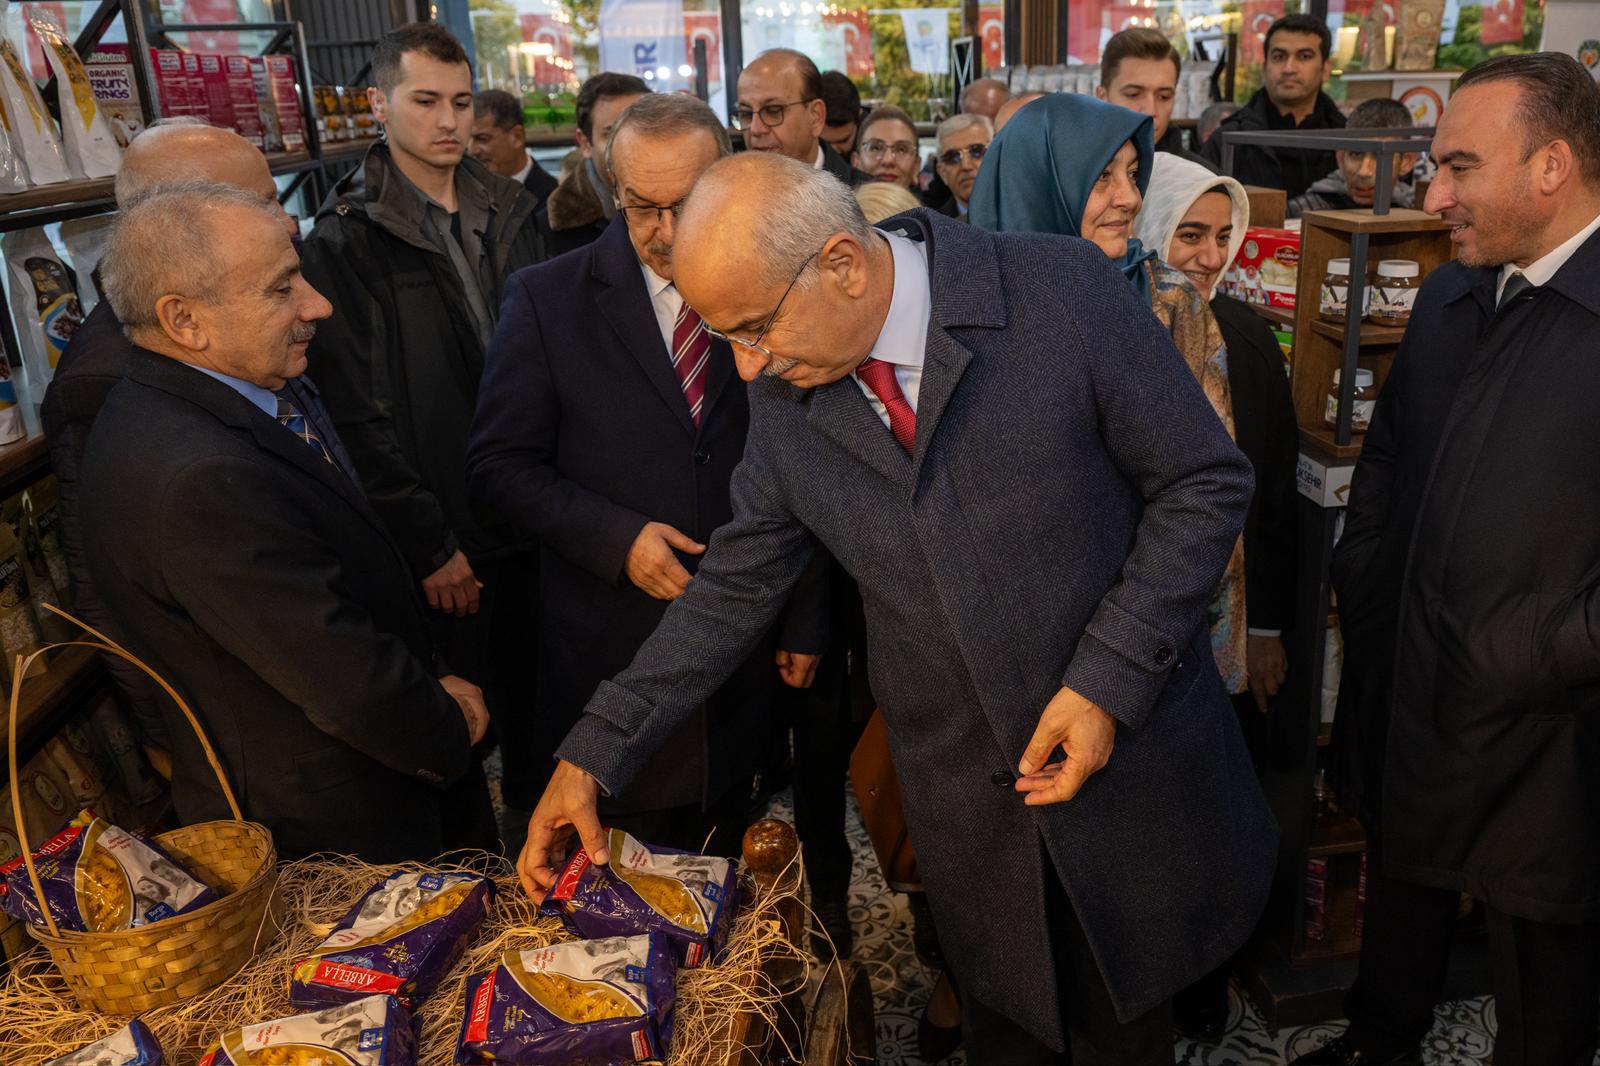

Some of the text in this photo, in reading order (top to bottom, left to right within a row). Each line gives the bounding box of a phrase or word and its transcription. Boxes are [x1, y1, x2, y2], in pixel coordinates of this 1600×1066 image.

[89, 69, 127, 78] ORGANIC
[90, 77, 130, 89] FRUITY
[94, 88, 130, 100] RINGS
[40, 834, 76, 856] BELLA
[570, 851, 589, 876] ARBEL
[324, 966, 377, 986] ARBELLA
[473, 976, 493, 1022] ARBELLA
